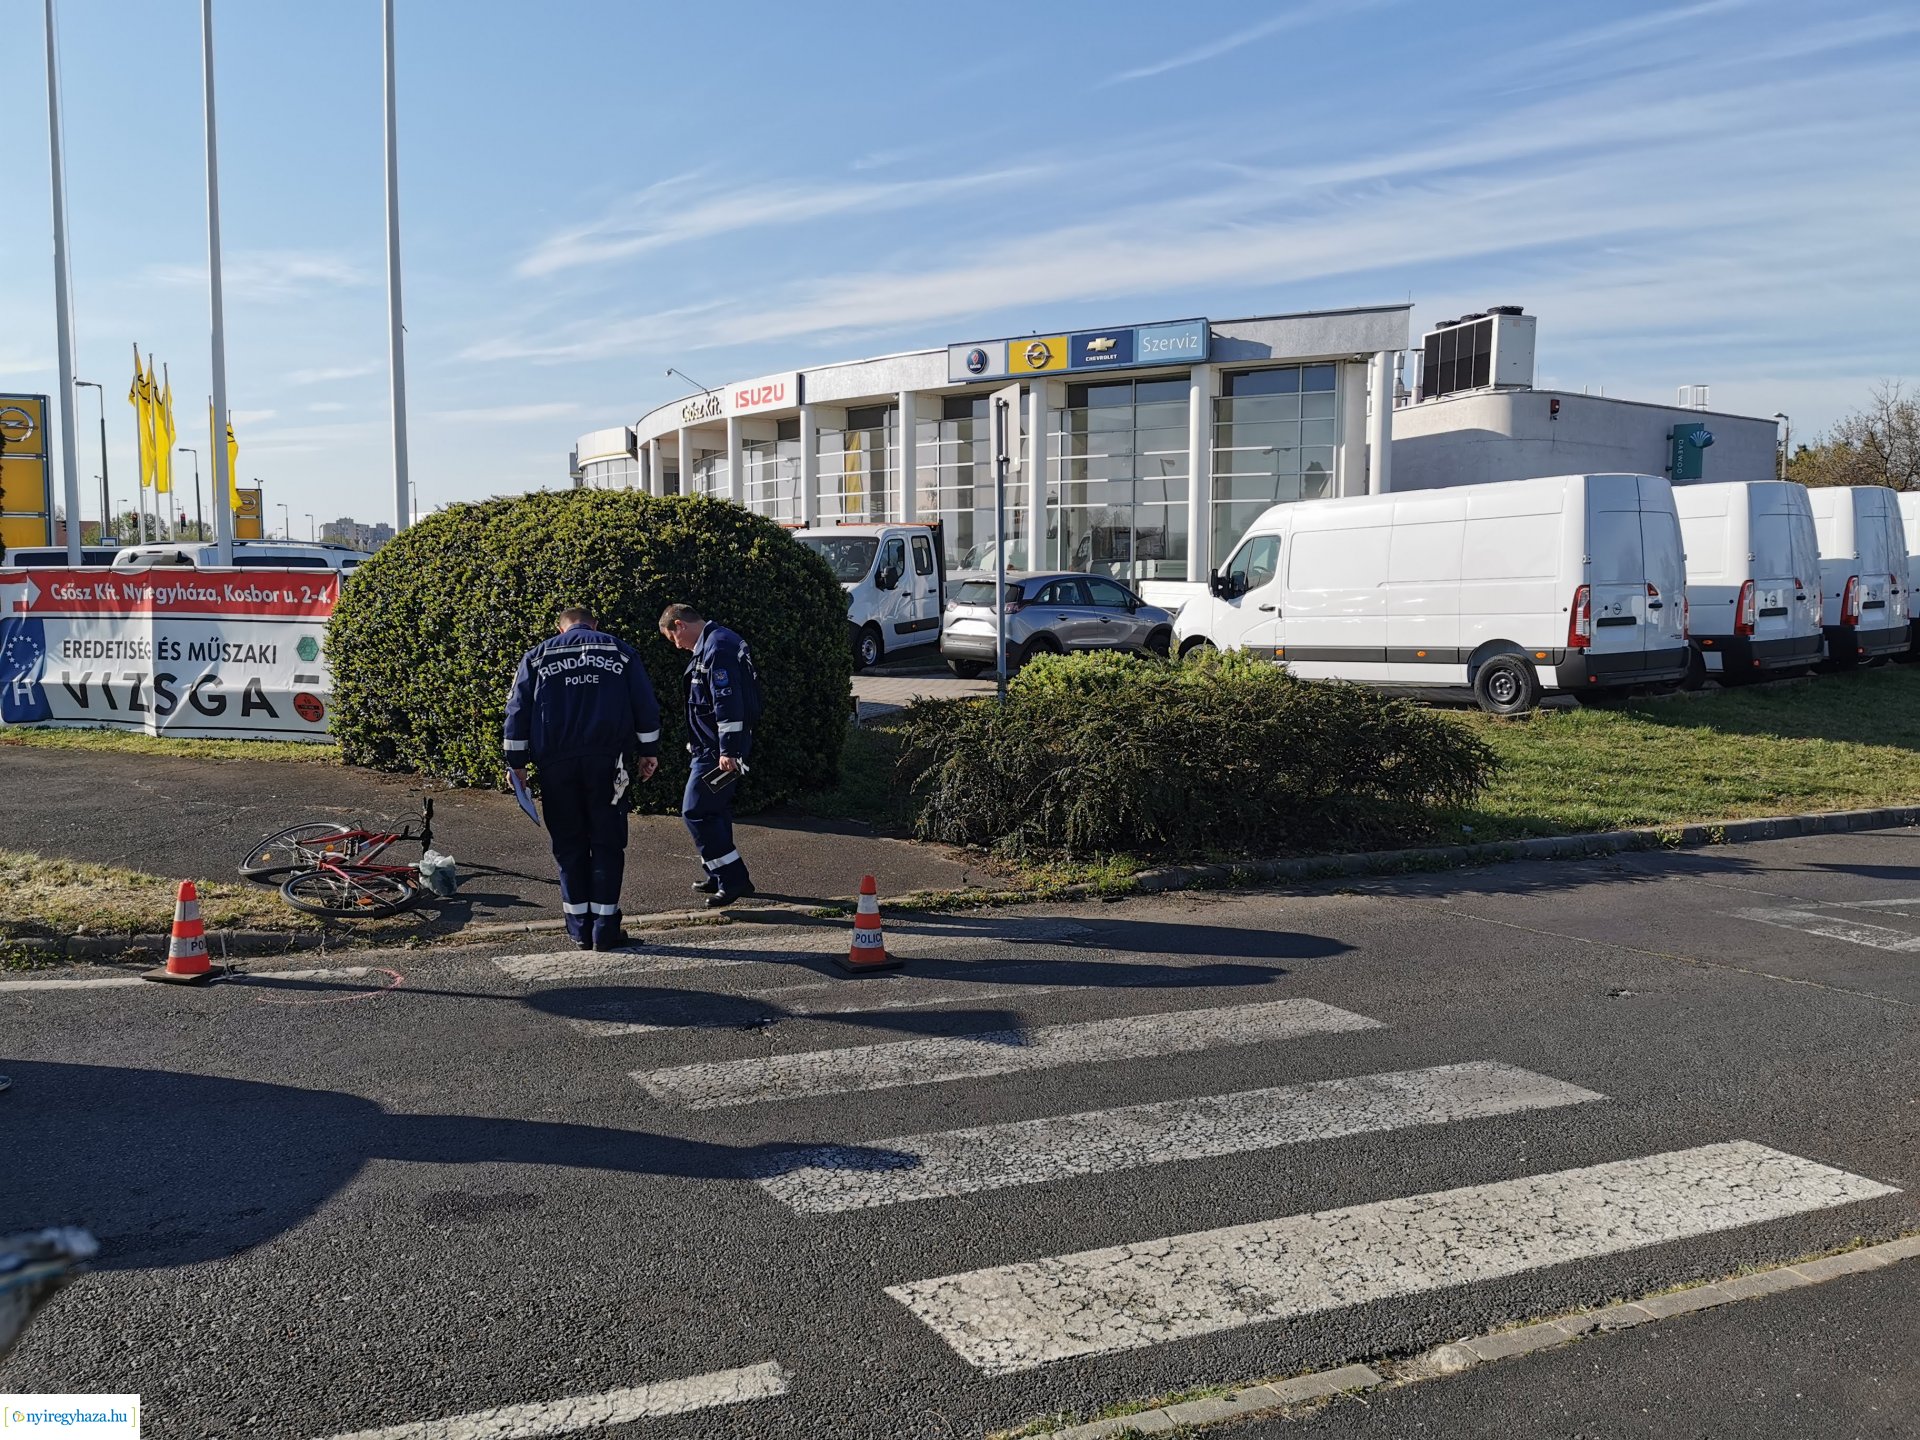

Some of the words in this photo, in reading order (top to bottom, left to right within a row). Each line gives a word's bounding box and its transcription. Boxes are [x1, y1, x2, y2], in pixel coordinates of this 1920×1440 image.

[1143, 332, 1198, 352] Szerviz
[1085, 354, 1118, 362] CHEVROLET
[735, 383, 784, 409] ISUZU
[1676, 439, 1684, 474] DAEWOO
[51, 583, 92, 600] Csősz
[94, 583, 120, 600] Kft.
[223, 583, 280, 603] Kosbor
[283, 589, 298, 604] u.
[300, 585, 331, 604] 2-4.
[62, 636, 152, 660] EREDETISÉG
[157, 636, 181, 661] ÉS
[188, 636, 277, 665] MŰSZAKI
[13, 672, 36, 706] H
[565, 674, 600, 686] POLICE
[61, 671, 280, 719] VIZSGA
